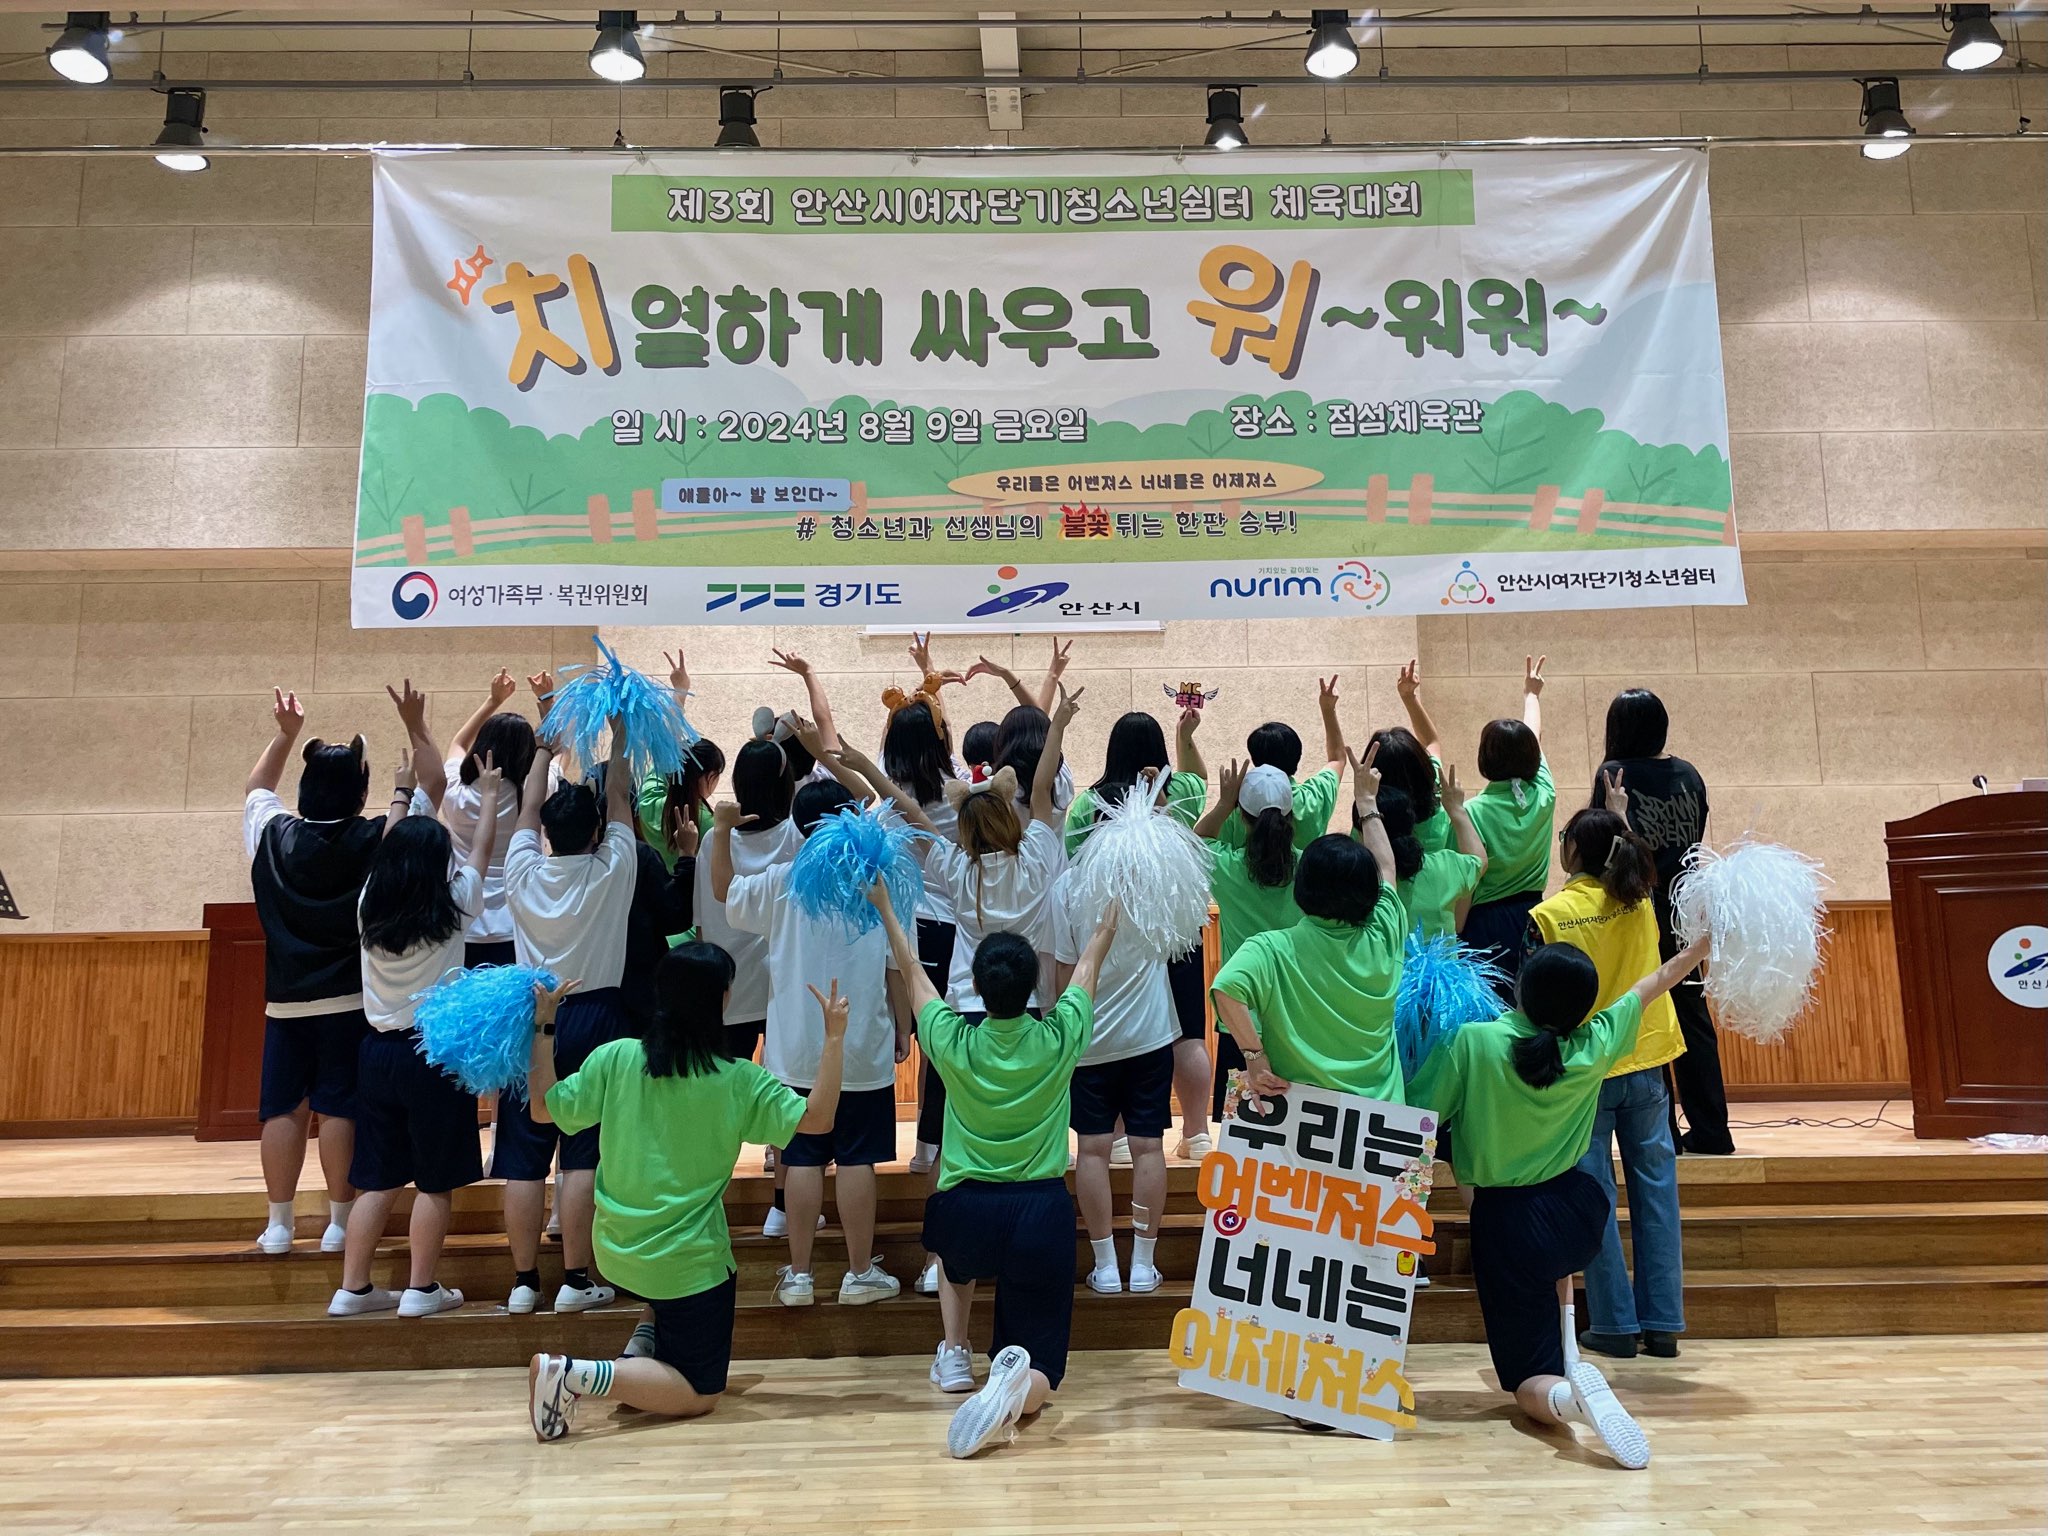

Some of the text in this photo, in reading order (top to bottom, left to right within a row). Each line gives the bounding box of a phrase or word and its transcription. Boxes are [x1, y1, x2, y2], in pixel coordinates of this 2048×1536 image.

[667, 180, 1423, 226] 제3회 안산시여자단기청소년쉼터 체육대회
[910, 286, 1161, 368] 싸우고
[717, 407, 848, 444] 2024년
[858, 408, 914, 445] 8월
[925, 408, 982, 444] 9일
[992, 407, 1088, 443] 금요일
[1230, 404, 1297, 437] 장소
[1328, 400, 1485, 437] 점섬체육관
[774, 486, 838, 503] 보인다~
[831, 515, 932, 541] 청소년과
[944, 513, 1043, 540] 선생님의
[1175, 510, 1227, 537] 한판
[1239, 509, 1298, 536] 승부!
[814, 582, 902, 608] 경기도
[1210, 576, 1322, 598] nurim
[1497, 567, 1717, 593] 안산시여자단기청소년쉼터
[1058, 600, 1141, 616] 안산시
[1179, 682, 1202, 695] MC
[1228, 1092, 1425, 1178] 우리는
[1197, 1151, 1437, 1256] 어벤져스
[1208, 1237, 1407, 1337] 너네는
[1168, 1307, 1418, 1430] 어제져스
